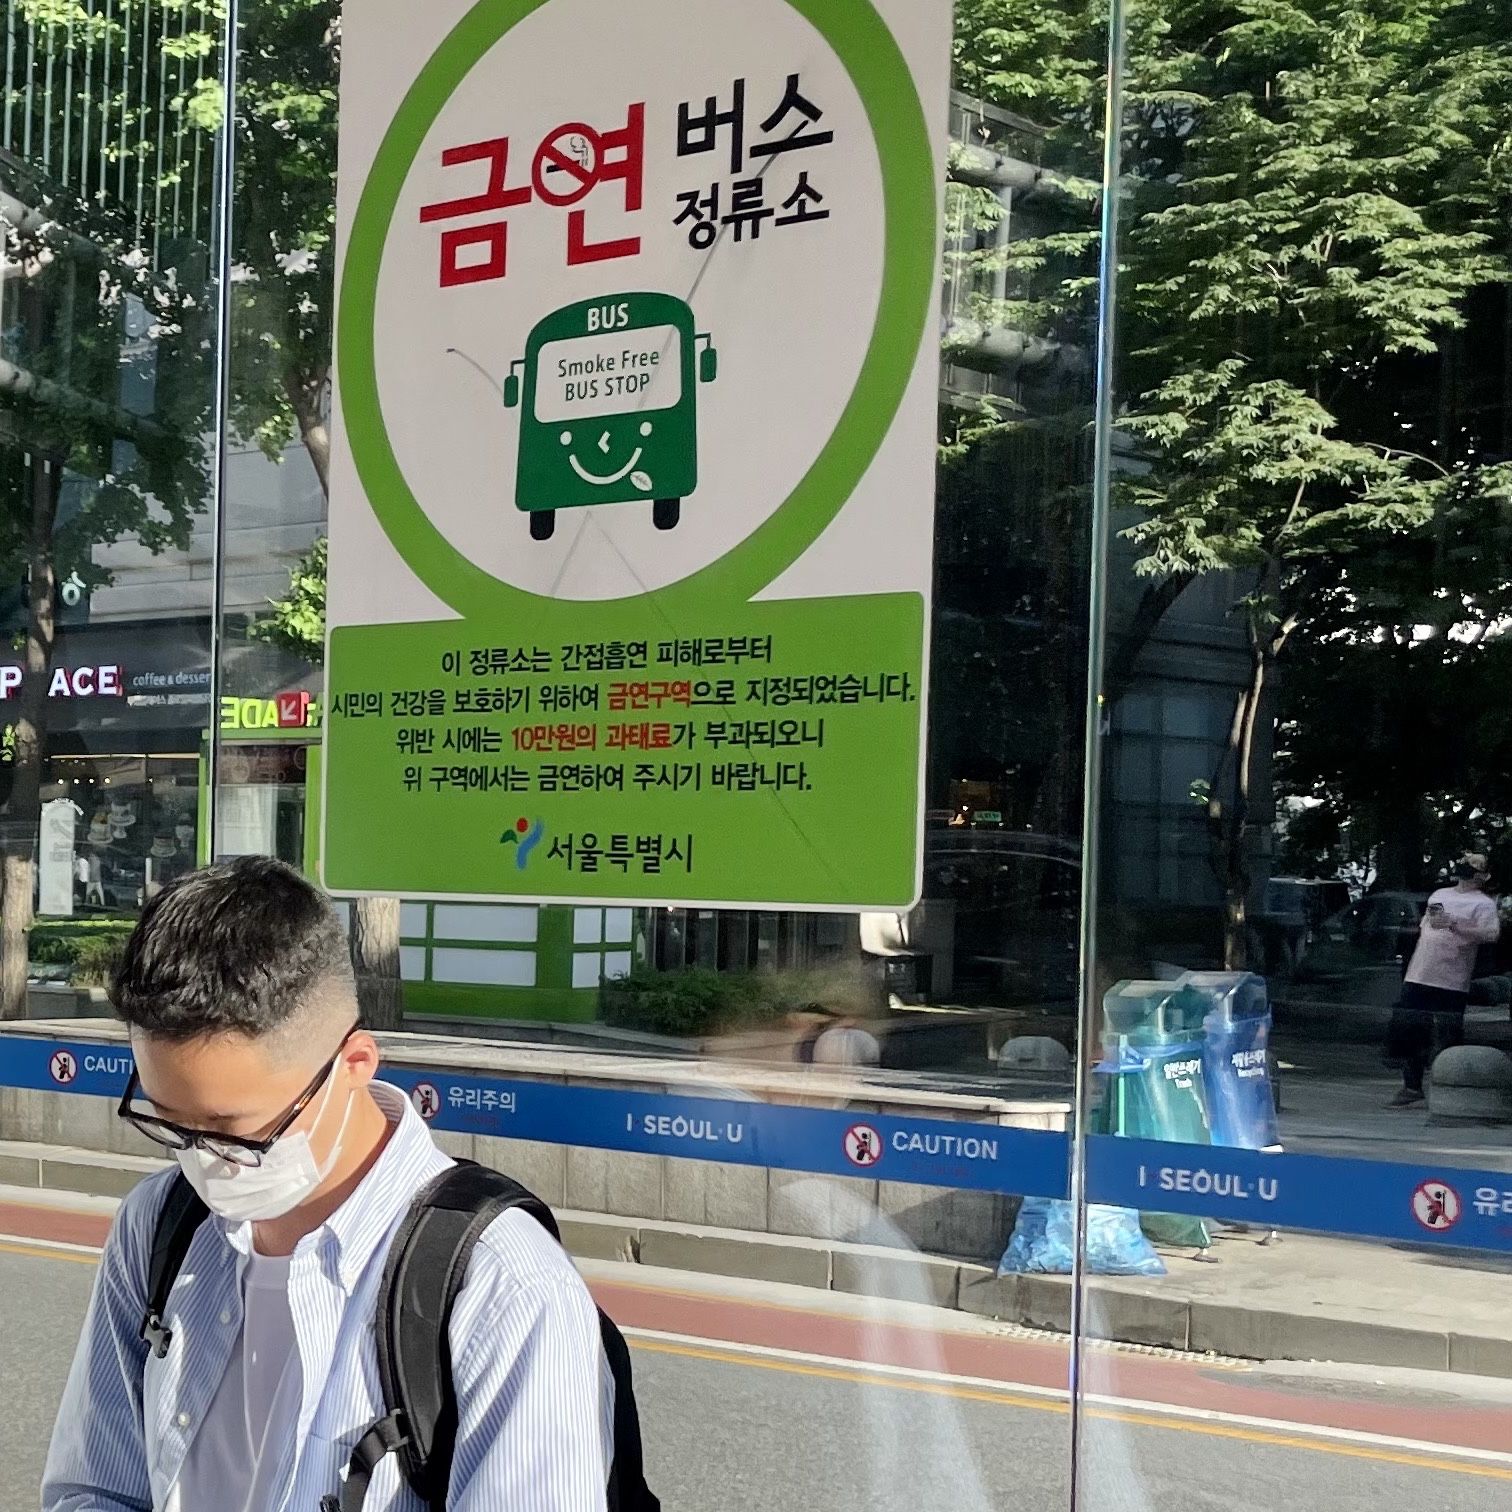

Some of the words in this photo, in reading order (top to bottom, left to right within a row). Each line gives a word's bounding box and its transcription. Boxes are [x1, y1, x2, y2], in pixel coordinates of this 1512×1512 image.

[420, 101, 646, 288] 금연
[677, 73, 833, 174] 버스
[672, 171, 831, 250] 정류소
[587, 302, 629, 333] BUS
[558, 351, 615, 378] Smoke
[621, 347, 660, 372] Free
[564, 378, 598, 401] BUS
[604, 372, 651, 398] STOP
[442, 651, 461, 676] 이
[469, 647, 552, 676] 정류소는
[561, 642, 647, 674] 간접흡연
[656, 635, 773, 669] 피해로부터
[0, 664, 122, 700] PACE
[133, 673, 165, 687] coffee
[175, 671, 211, 685] desser
[332, 692, 383, 719] 시민의
[390, 689, 446, 717] 건강을
[452, 686, 531, 715] 보호하기
[538, 684, 600, 713] 위하여
[608, 679, 737, 712] 금연구역으로
[747, 672, 916, 706] 지정되었습니다.
[396, 728, 434, 754] 위반
[442, 726, 502, 754] 시에는
[510, 723, 597, 752] 10만원의
[605, 720, 696, 751] 과태료가
[704, 718, 824, 749] 부과되오니
[403, 766, 422, 793] 위
[429, 765, 530, 793] 구역에서는
[538, 763, 624, 792] 금연하여
[633, 763, 701, 792] 주시기
[711, 762, 812, 792] 바랍니다.
[546, 833, 694, 875] 서울특별시
[84, 1055, 134, 1076] CAUTI
[448, 1086, 516, 1114] 유리주의
[892, 1131, 998, 1161] CAUTION
